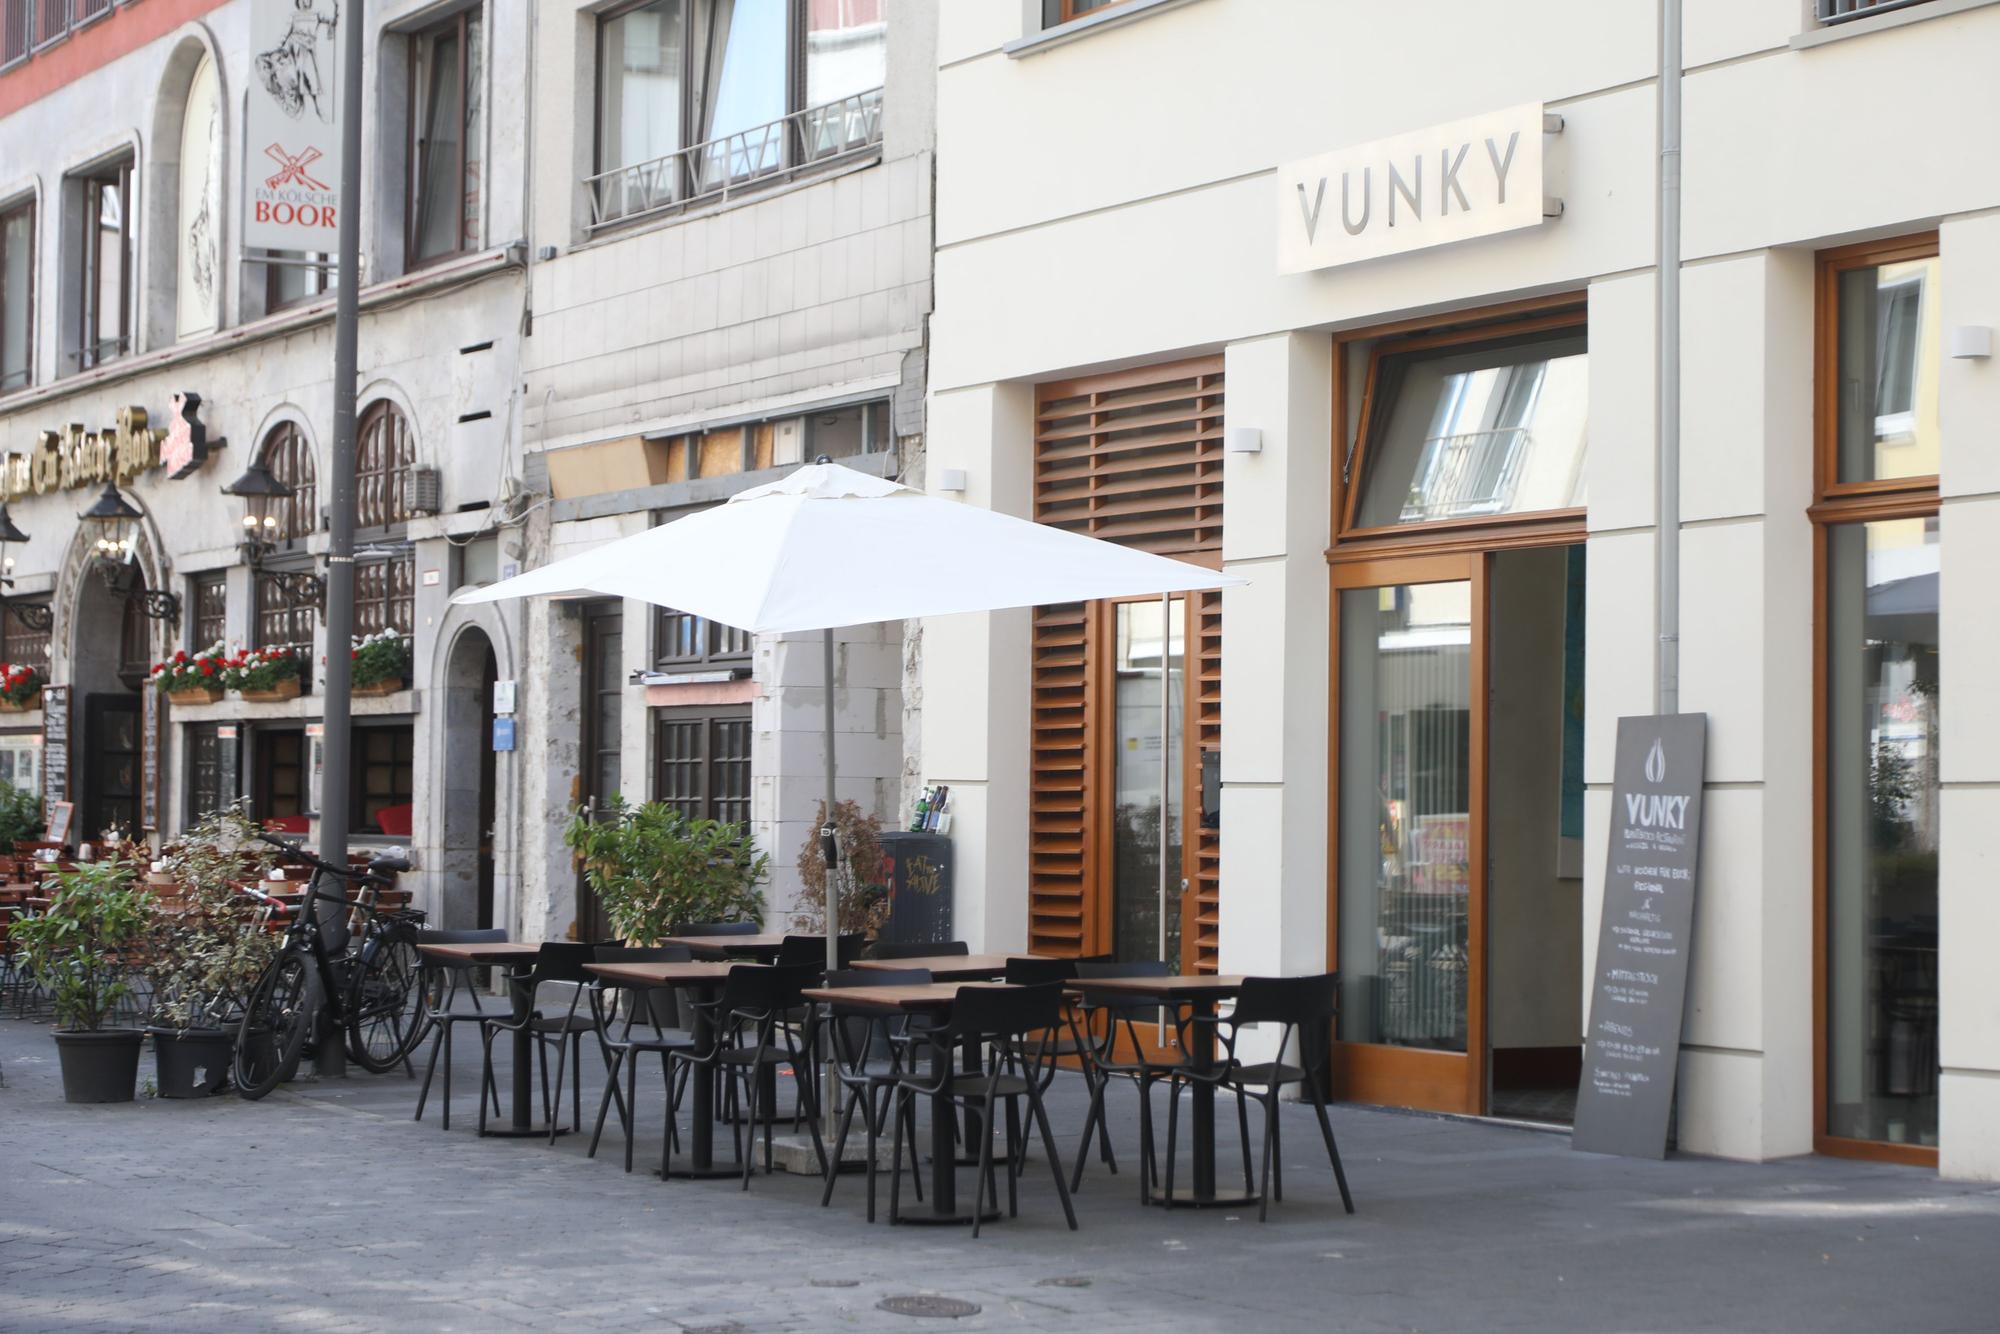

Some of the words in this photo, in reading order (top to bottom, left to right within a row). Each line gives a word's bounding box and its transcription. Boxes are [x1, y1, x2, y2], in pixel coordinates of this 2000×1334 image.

[255, 187, 274, 200] EM
[278, 188, 338, 206] KÖLSCHE
[1296, 130, 1521, 246] VUNKY
[255, 200, 336, 229] BOOR
[1625, 793, 1691, 830] VUNKY
